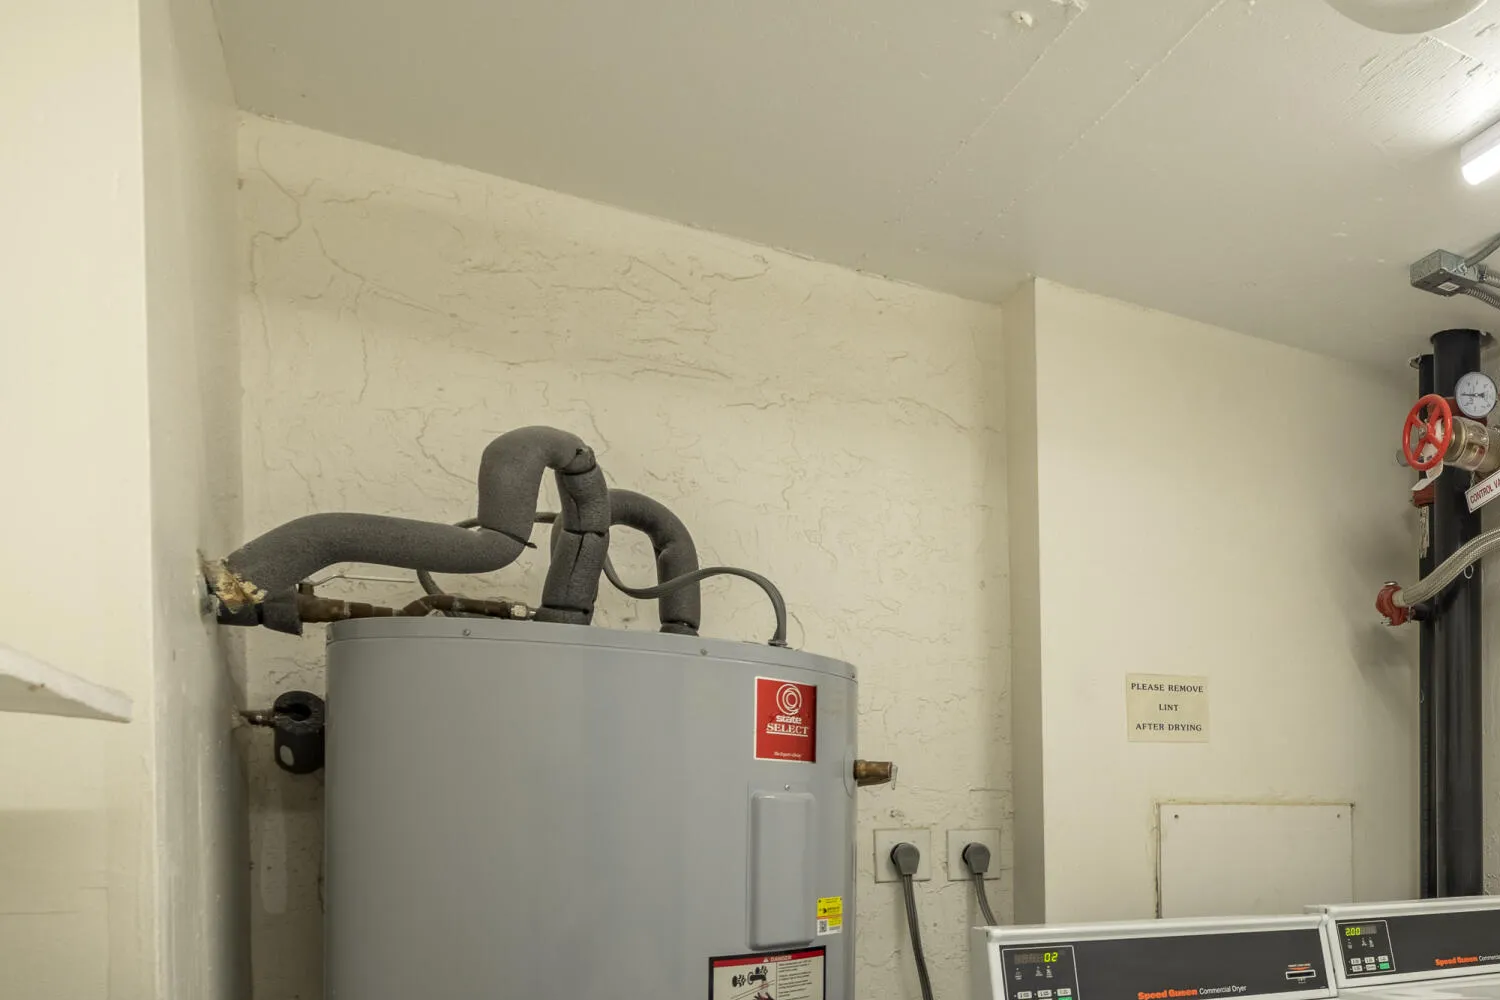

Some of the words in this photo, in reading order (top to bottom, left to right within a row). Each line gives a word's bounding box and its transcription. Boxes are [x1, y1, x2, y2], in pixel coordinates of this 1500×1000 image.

[1470, 485, 1493, 504] CONTROL
[1131, 683, 1165, 691] PLEASE
[1168, 685, 1204, 693] REMOVE
[776, 715, 802, 724] state
[766, 723, 808, 735] SELECT
[1136, 723, 1165, 731] AFTER
[1043, 952, 1059, 963] 02
[1138, 990, 1168, 1000] Speed
[1199, 986, 1231, 995] Commercial
[1231, 985, 1247, 994] Dryer
